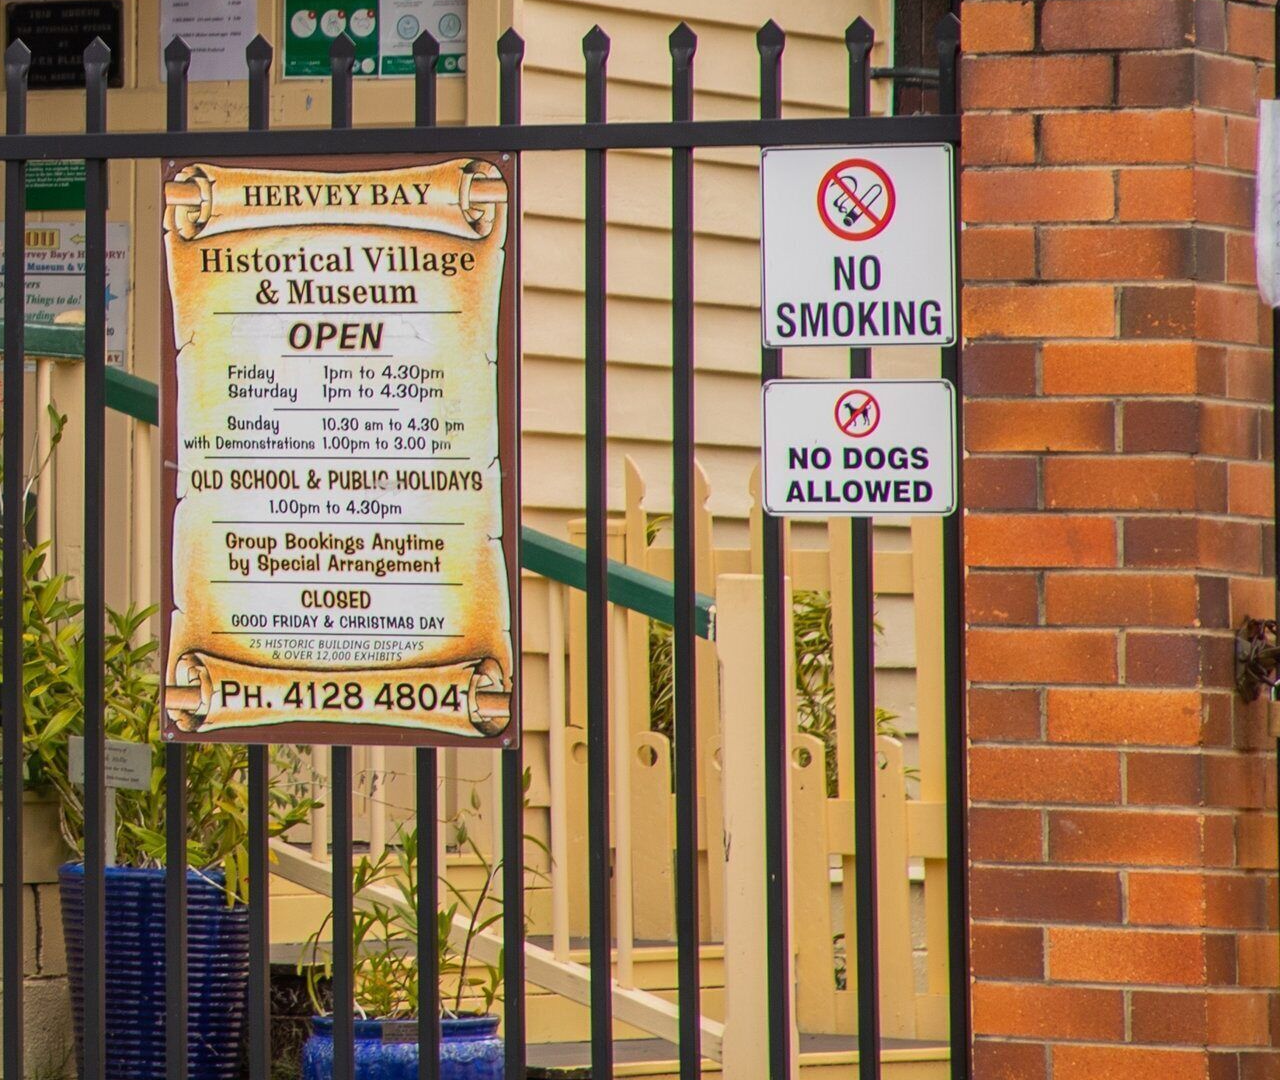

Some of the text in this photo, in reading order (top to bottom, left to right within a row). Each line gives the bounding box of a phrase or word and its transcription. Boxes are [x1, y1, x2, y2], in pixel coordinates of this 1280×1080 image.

[243, 183, 431, 207] HERVEY BAY
[200, 246, 475, 277] Historical Village
[834, 255, 882, 291] NO
[256, 279, 418, 304] & Museum
[776, 300, 942, 338] SMOKING
[289, 322, 384, 351] OPEN
[228, 366, 445, 382] Friday 1pm to 4.30pm
[228, 384, 444, 402] Saturday 1pm to 4.30pm
[227, 416, 465, 436] Sunday 10.30 am to 4.30 pm
[184, 437, 452, 454] with Demonstrations 1.00pm to 3.00 pm
[789, 447, 930, 470] NO DOGS
[191, 469, 483, 492] QLD SCHOOL & PUBLIC HOLIDAYS
[786, 480, 934, 503] ALLOWED
[269, 500, 402, 518] 1.00pm to 4.30pm
[225, 532, 444, 555] Group Bookings Anytime
[229, 554, 441, 577] by Special Arrangement
[301, 590, 371, 609] CLOSED
[231, 614, 445, 630] GOOD FRIDAY & CHRISTMAS DAY
[249, 639, 424, 651] 25 HISTORIC BUILDING DISPLAYS
[272, 650, 402, 662] & OVER 12,000 EXHIBITS
[283, 681, 364, 710] 4128
[374, 682, 461, 711] 4804
